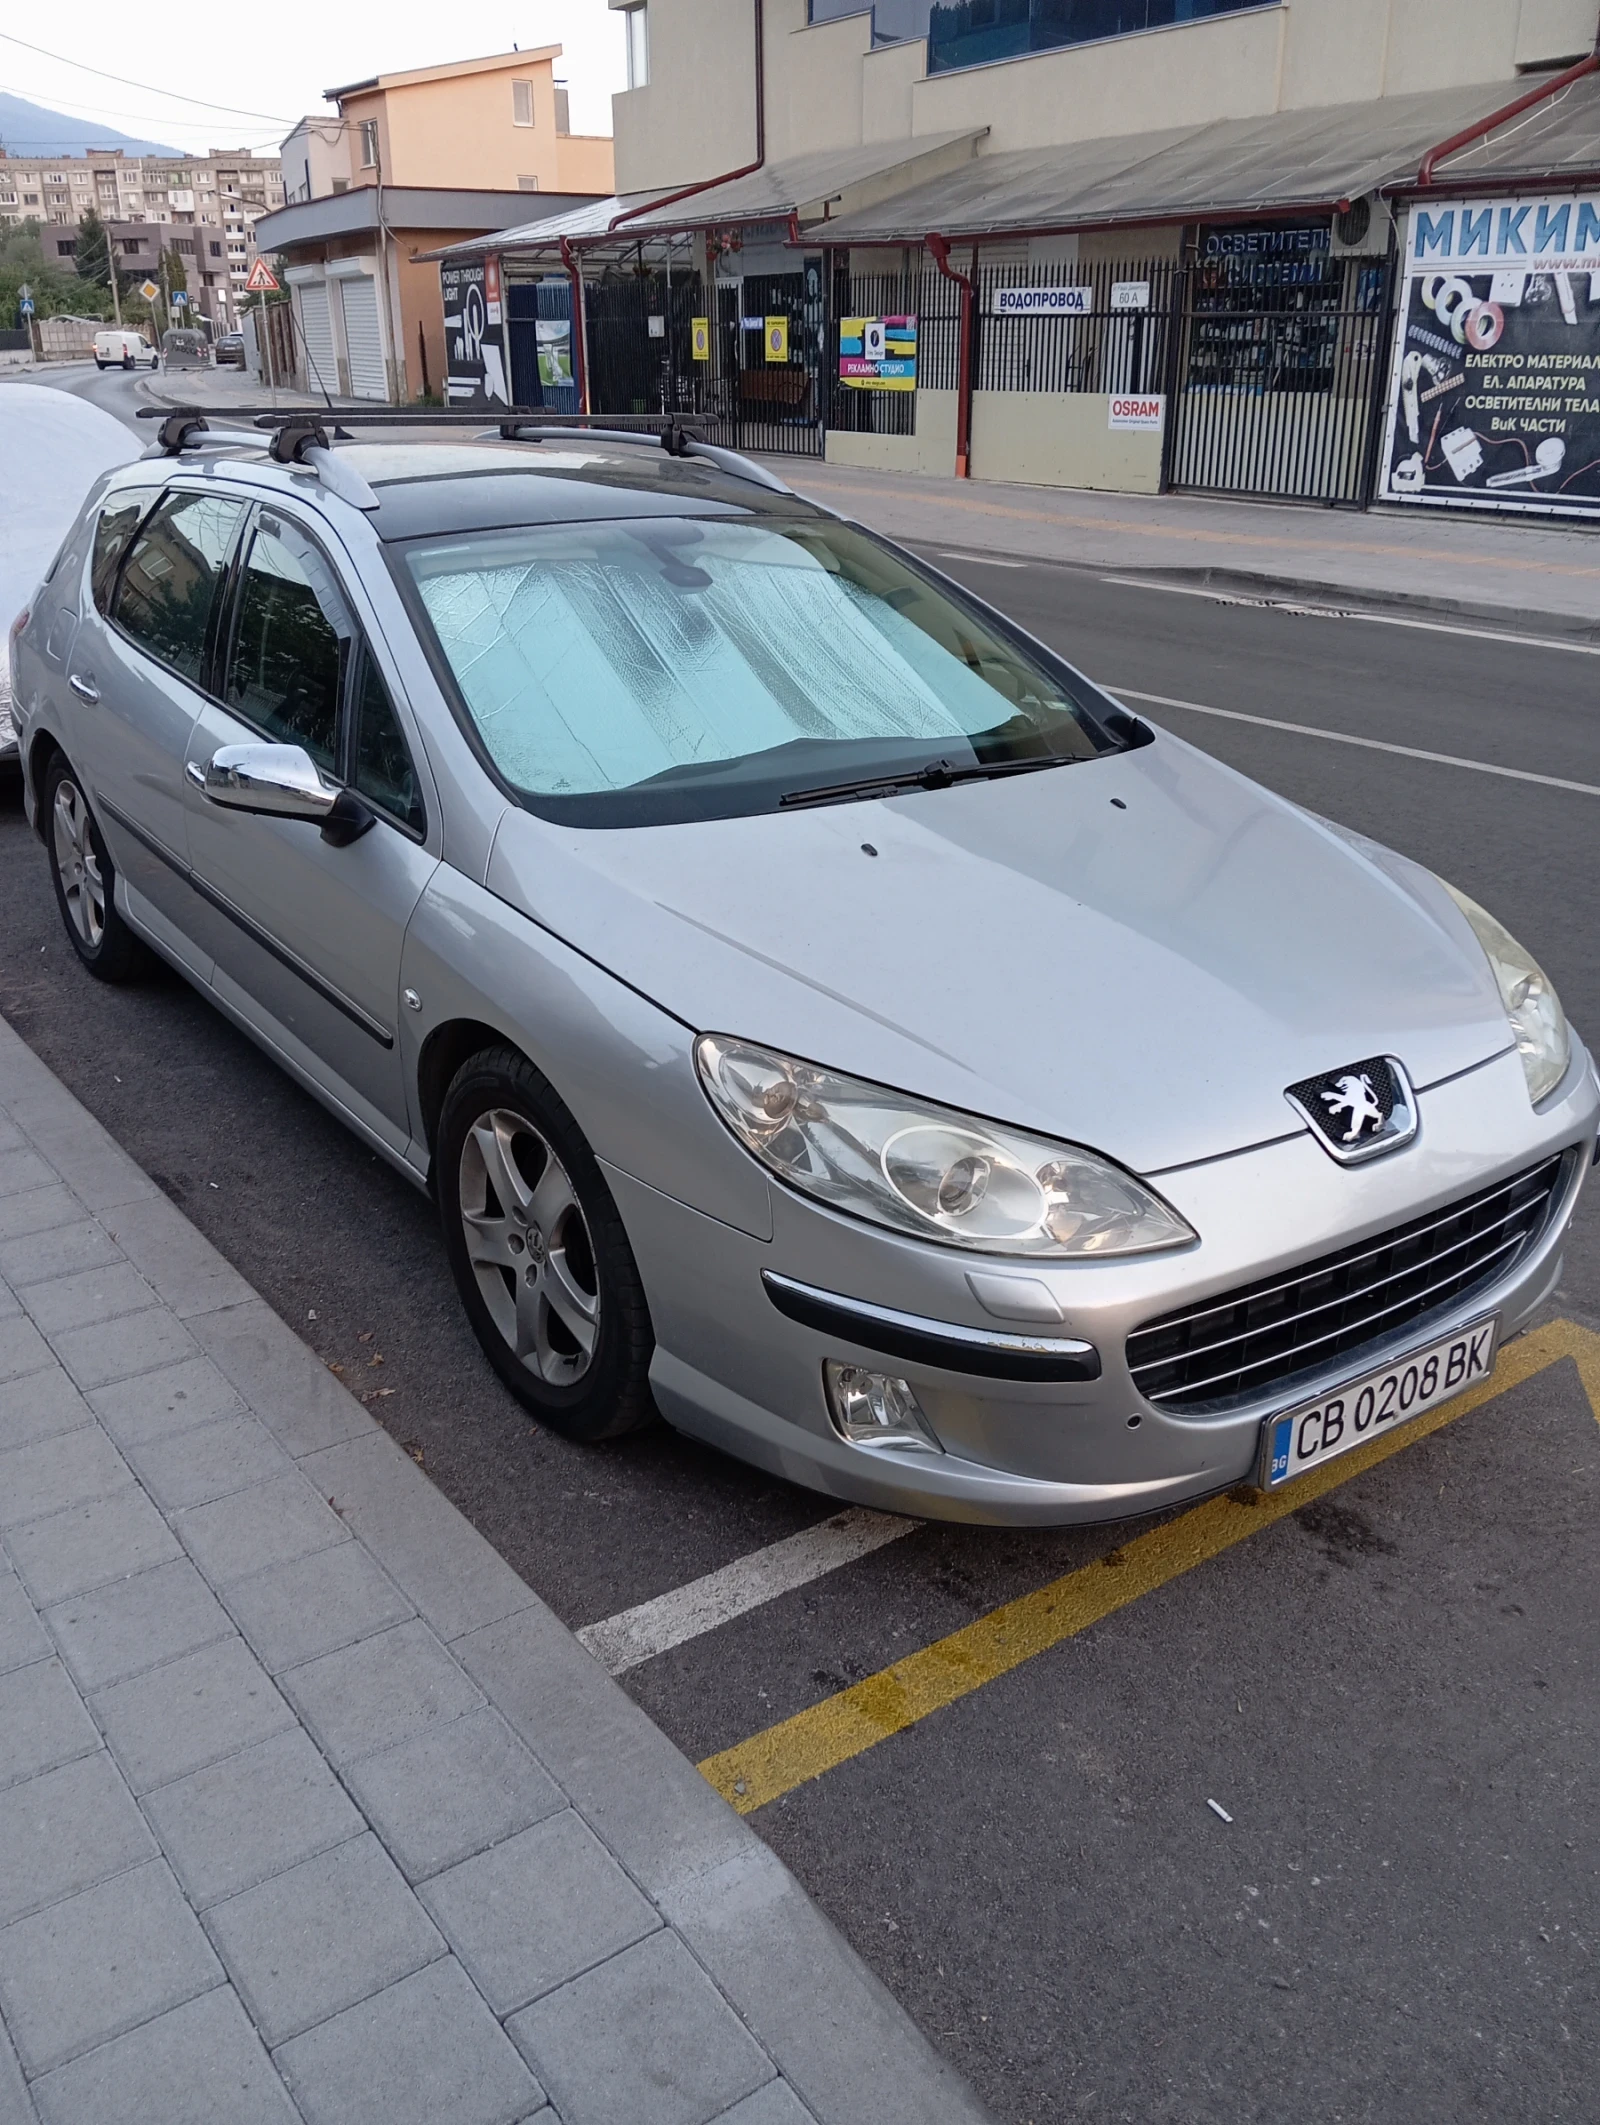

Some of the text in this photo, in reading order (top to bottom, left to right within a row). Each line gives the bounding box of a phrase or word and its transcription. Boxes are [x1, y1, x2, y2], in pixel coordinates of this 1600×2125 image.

[442, 267, 485, 284] POWER THROUGH
[1000, 292, 1084, 311] ВОДОПРОВОД
[1119, 292, 1130, 304] 60
[847, 363, 905, 374] РЕКЛАМНО СТУДИО
[1465, 354, 1525, 368] ЕЛЕКТРО
[1483, 375, 1586, 391] ЕЛ. АПАРАТУРА
[1112, 400, 1159, 417] OSRAM
[1465, 395, 1600, 413] ОСВЕТИТЕЛНИ ТЕЛА
[1520, 418, 1567, 433] ЧАСТИ
[1354, 1355, 1439, 1432] 0208
[1271, 1455, 1287, 1473] BG
